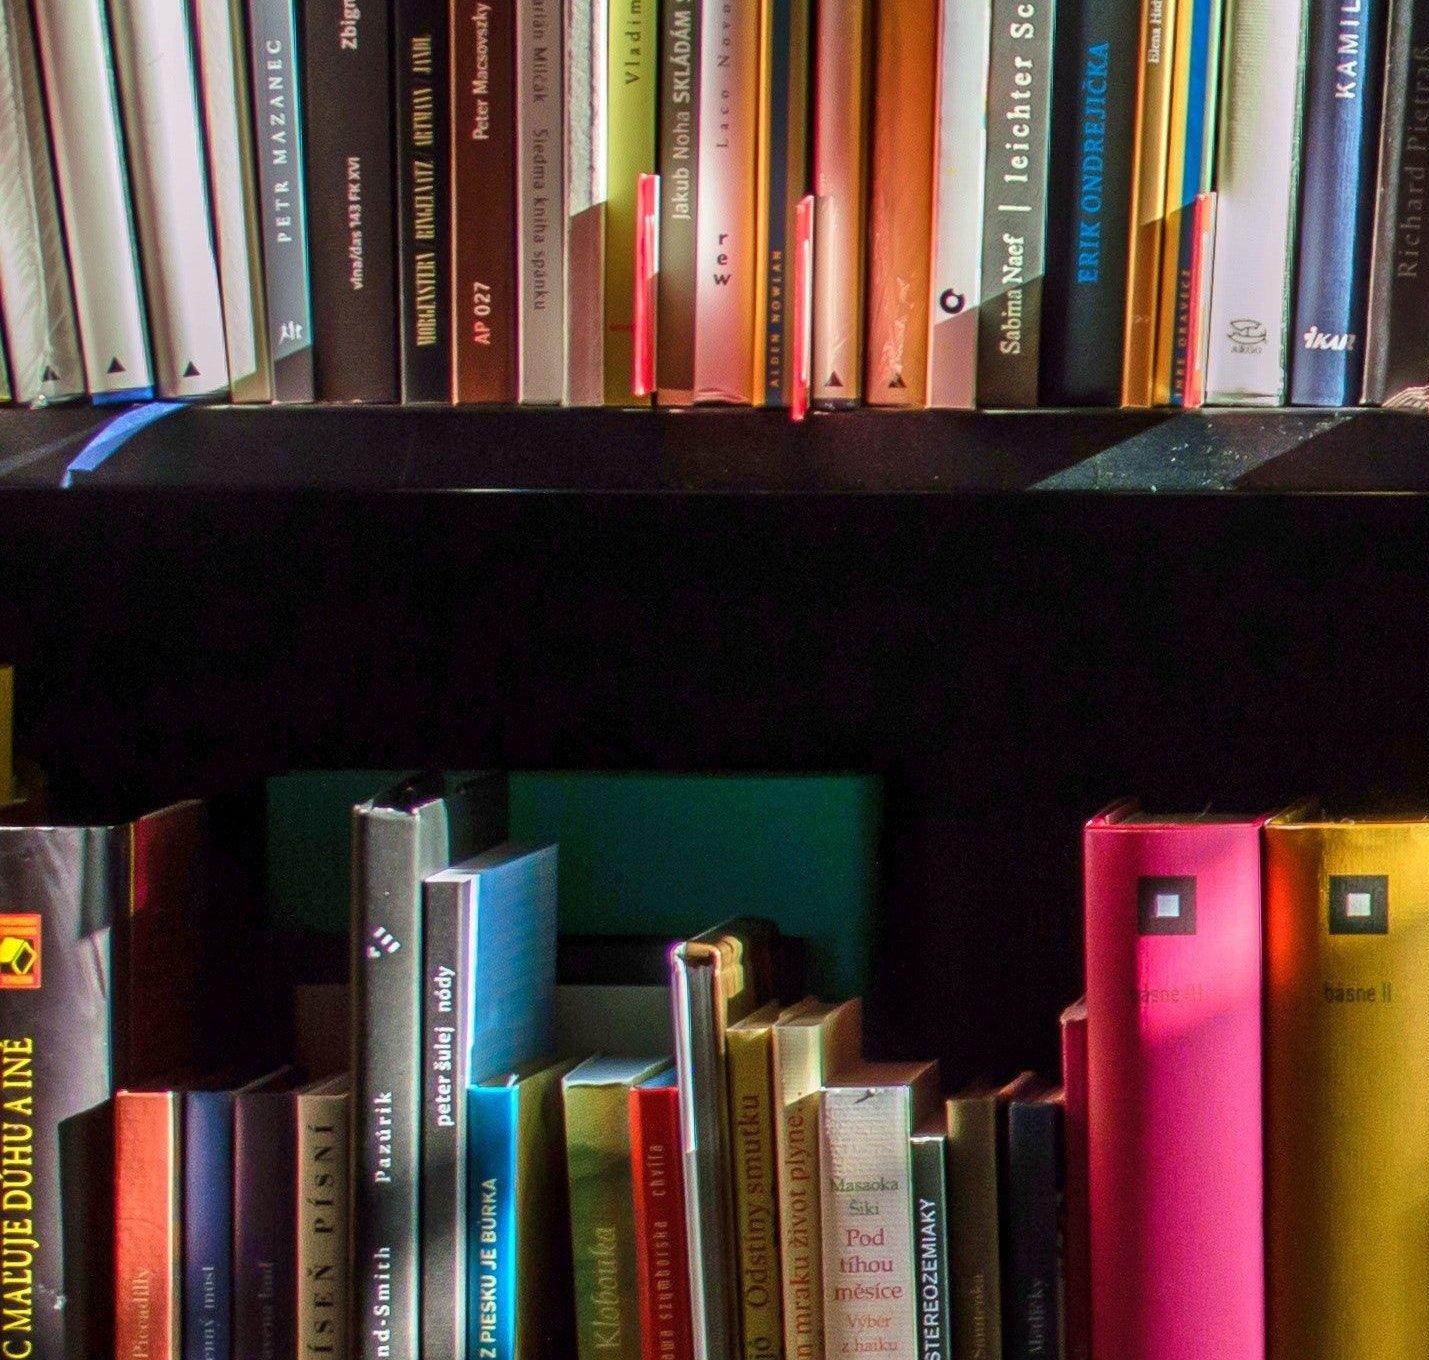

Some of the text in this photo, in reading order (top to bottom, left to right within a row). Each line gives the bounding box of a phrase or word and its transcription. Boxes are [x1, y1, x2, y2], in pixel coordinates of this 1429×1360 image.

[266, 40, 292, 242] PETR MAZANEC
[672, 111, 691, 219] Jakub Noha
[1000, 56, 1033, 354] Sabina Naef leichter
[0, 1038, 33, 1088] INÉ
[433, 966, 455, 1126] peter šulej nódy
[2, 1089, 32, 1115] A
[373, 1091, 393, 1183] Pazúrik
[0, 1123, 33, 1211] DÚHU
[2, 1219, 39, 1332] MAĽUJE
